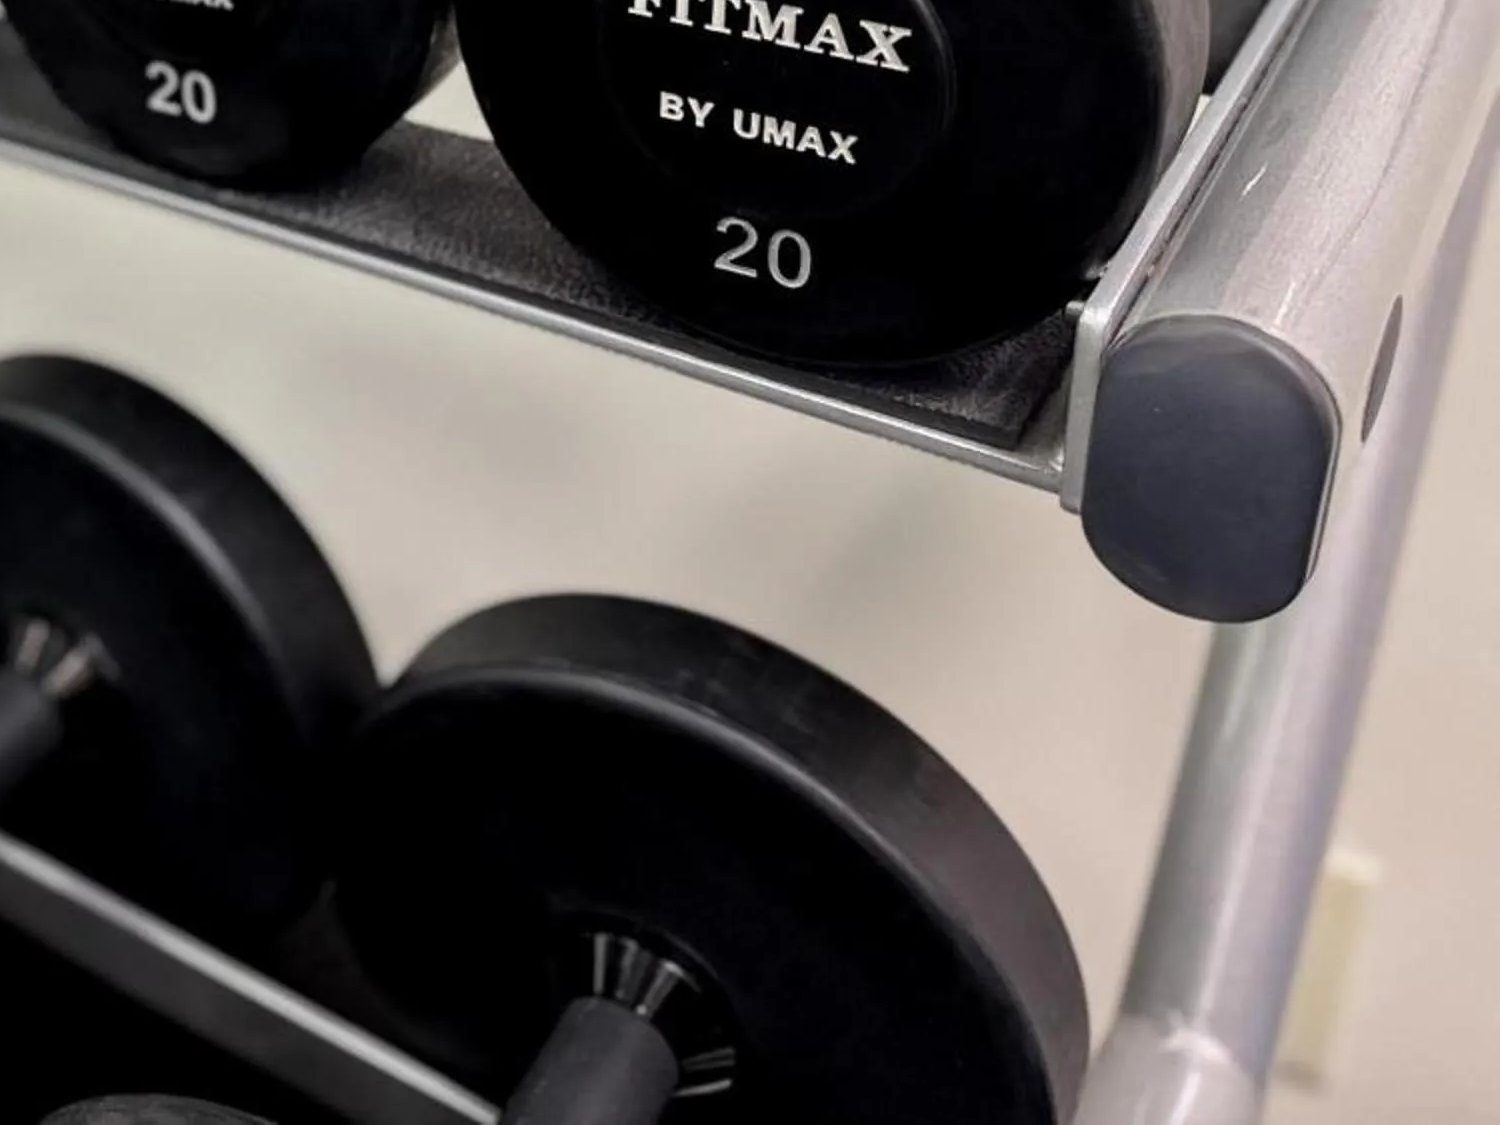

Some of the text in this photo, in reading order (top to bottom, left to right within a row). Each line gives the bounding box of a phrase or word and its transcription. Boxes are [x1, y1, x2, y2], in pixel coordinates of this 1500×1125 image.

[144, 60, 217, 124] 20
[658, 90, 859, 165] BY UMAX
[712, 216, 812, 289] 20
